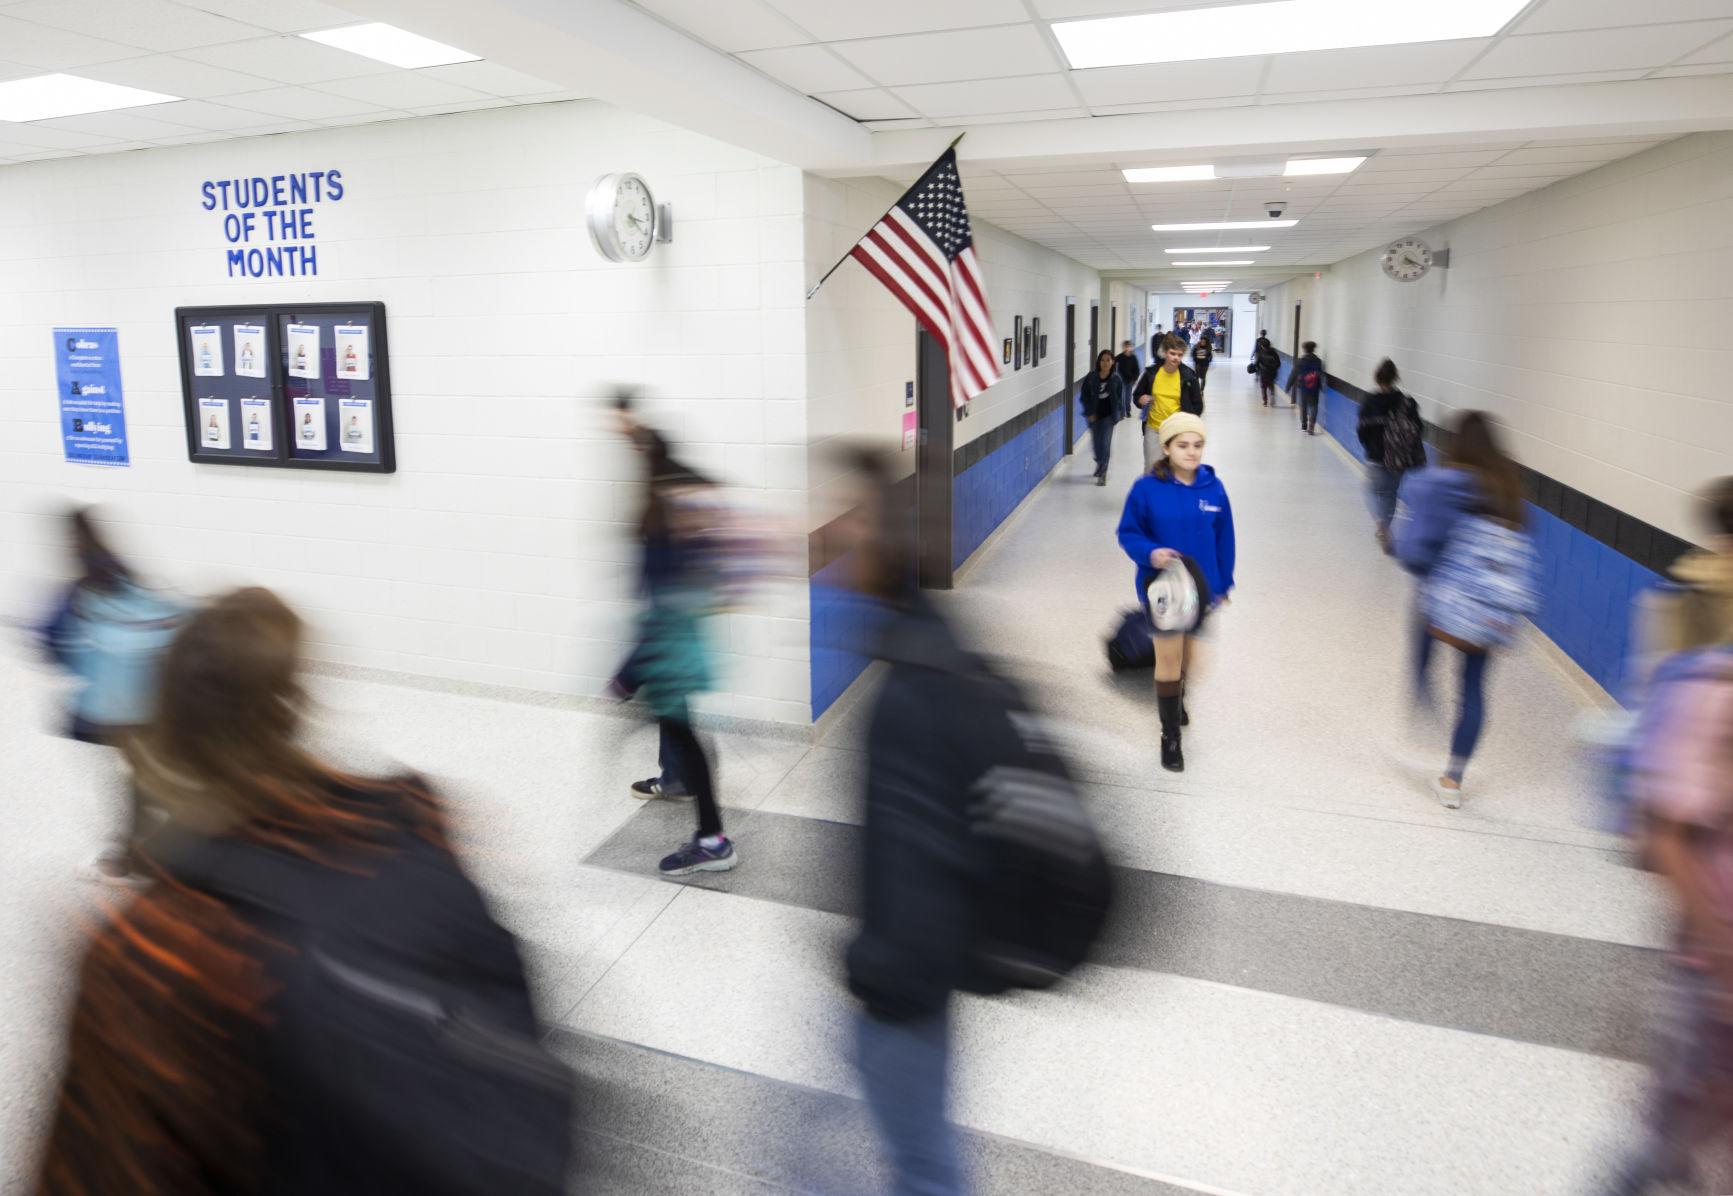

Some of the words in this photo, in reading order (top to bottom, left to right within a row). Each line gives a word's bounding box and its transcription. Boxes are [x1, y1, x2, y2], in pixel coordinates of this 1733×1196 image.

[202, 169, 343, 210] STUDENTS
[224, 213, 255, 243] OF
[262, 208, 315, 241] THE
[227, 245, 317, 278] MONTH
